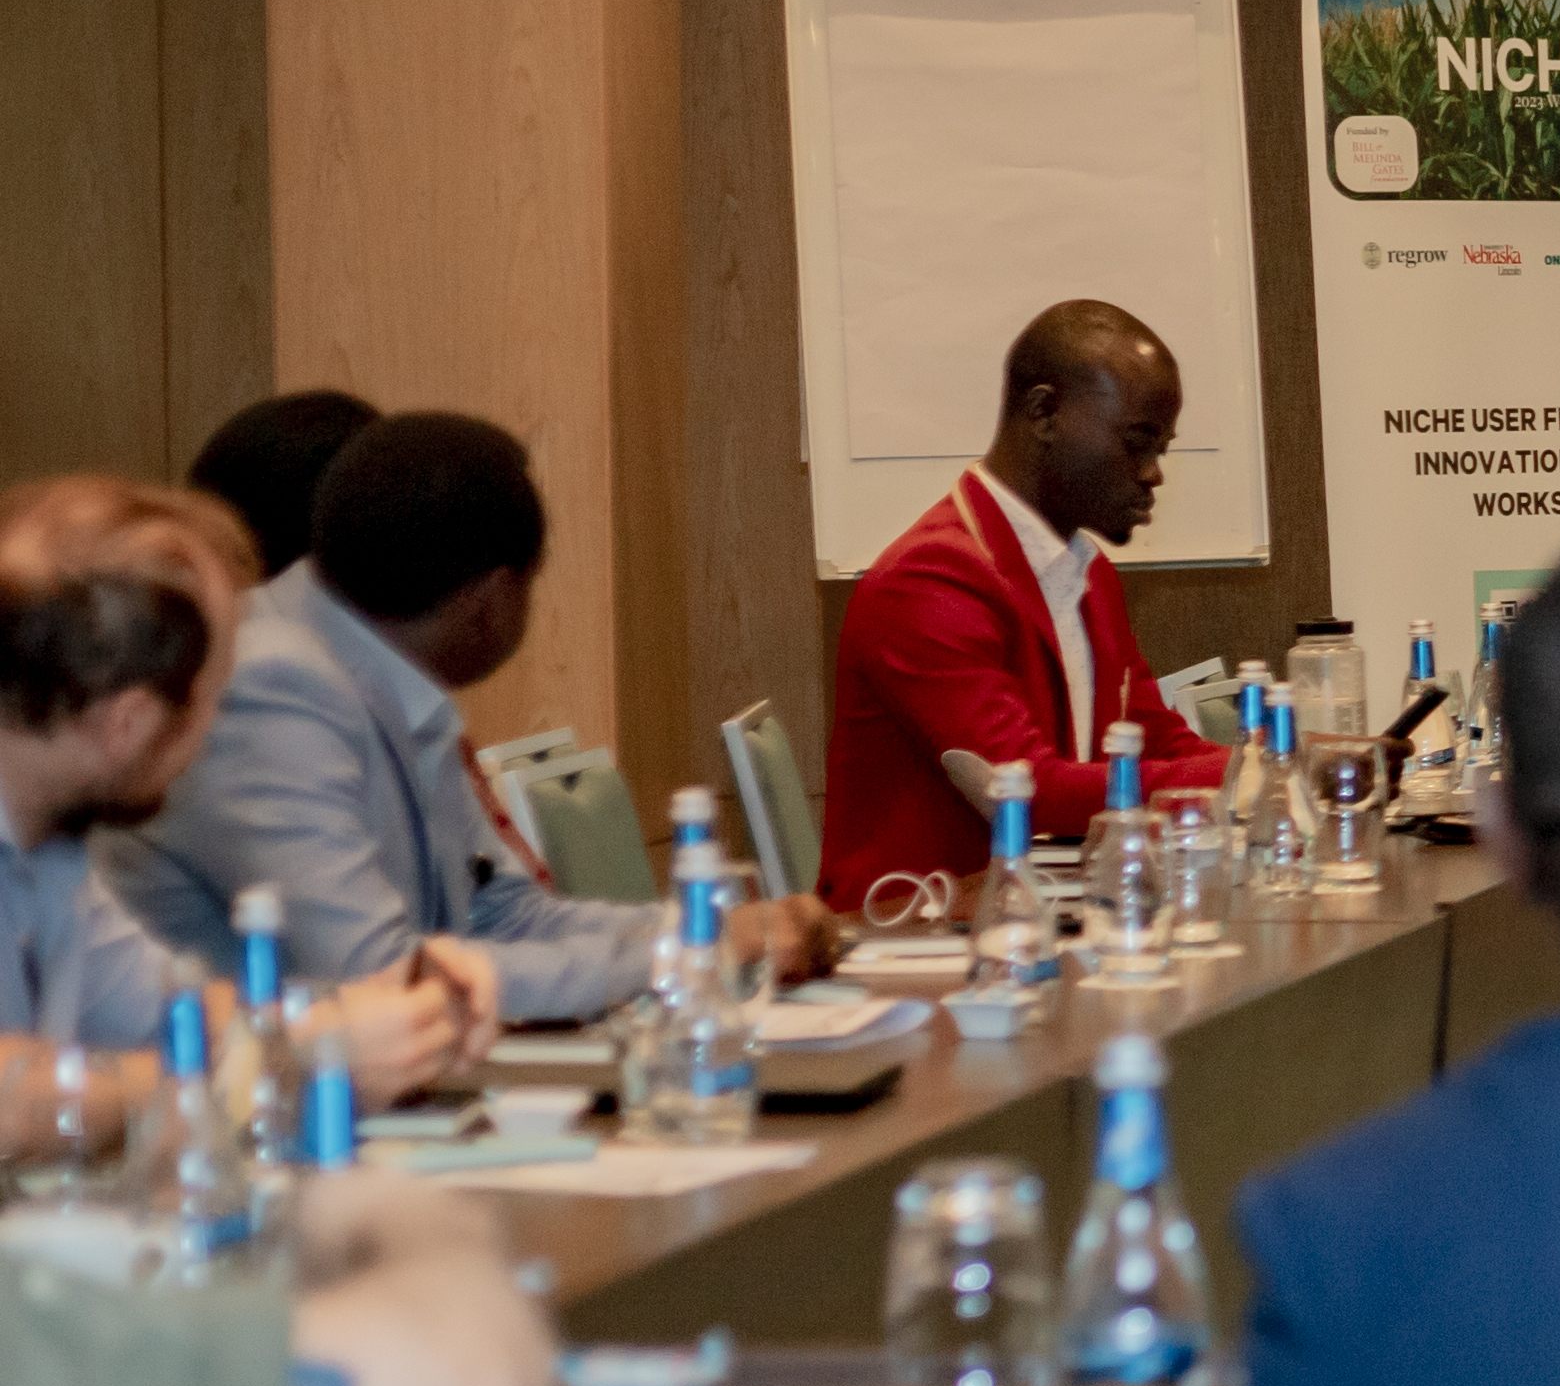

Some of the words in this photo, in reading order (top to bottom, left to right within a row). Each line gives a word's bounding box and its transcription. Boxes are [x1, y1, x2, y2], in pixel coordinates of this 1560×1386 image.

[1514, 95, 1544, 110] 2023
[1387, 250, 1448, 268] regrow
[1463, 244, 1521, 263] Nebraska
[1384, 409, 1464, 434] NICHE
[1471, 408, 1536, 432] USER
